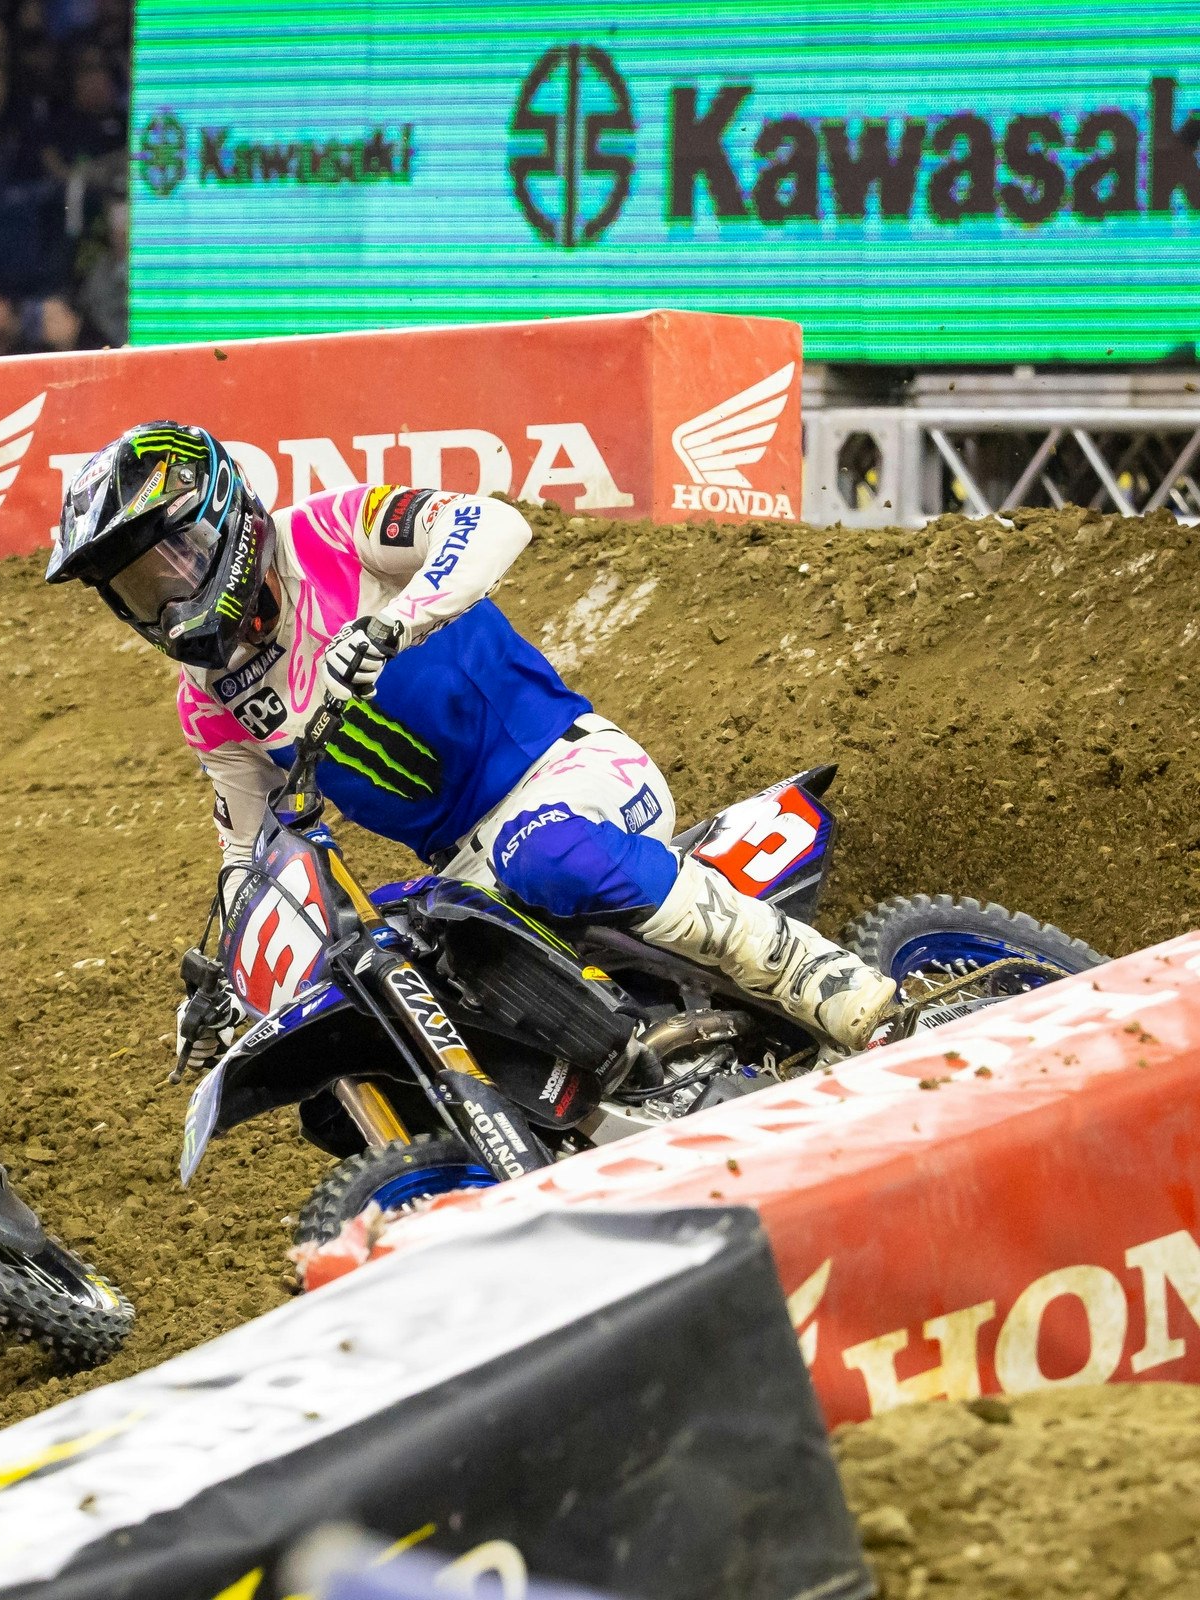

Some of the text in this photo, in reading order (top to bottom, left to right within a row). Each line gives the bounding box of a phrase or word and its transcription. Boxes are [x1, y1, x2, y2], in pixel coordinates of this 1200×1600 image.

[49, 422, 636, 543] NDA
[671, 484, 796, 520] HONDA
[226, 512, 254, 591] MONSTER
[424, 506, 481, 590] ASTARS
[501, 809, 570, 868] ASTARS
[698, 798, 818, 883] 3
[232, 869, 262, 920] MONSTE
[240, 859, 329, 1015] 3
[463, 1100, 525, 1180] UNLOP
